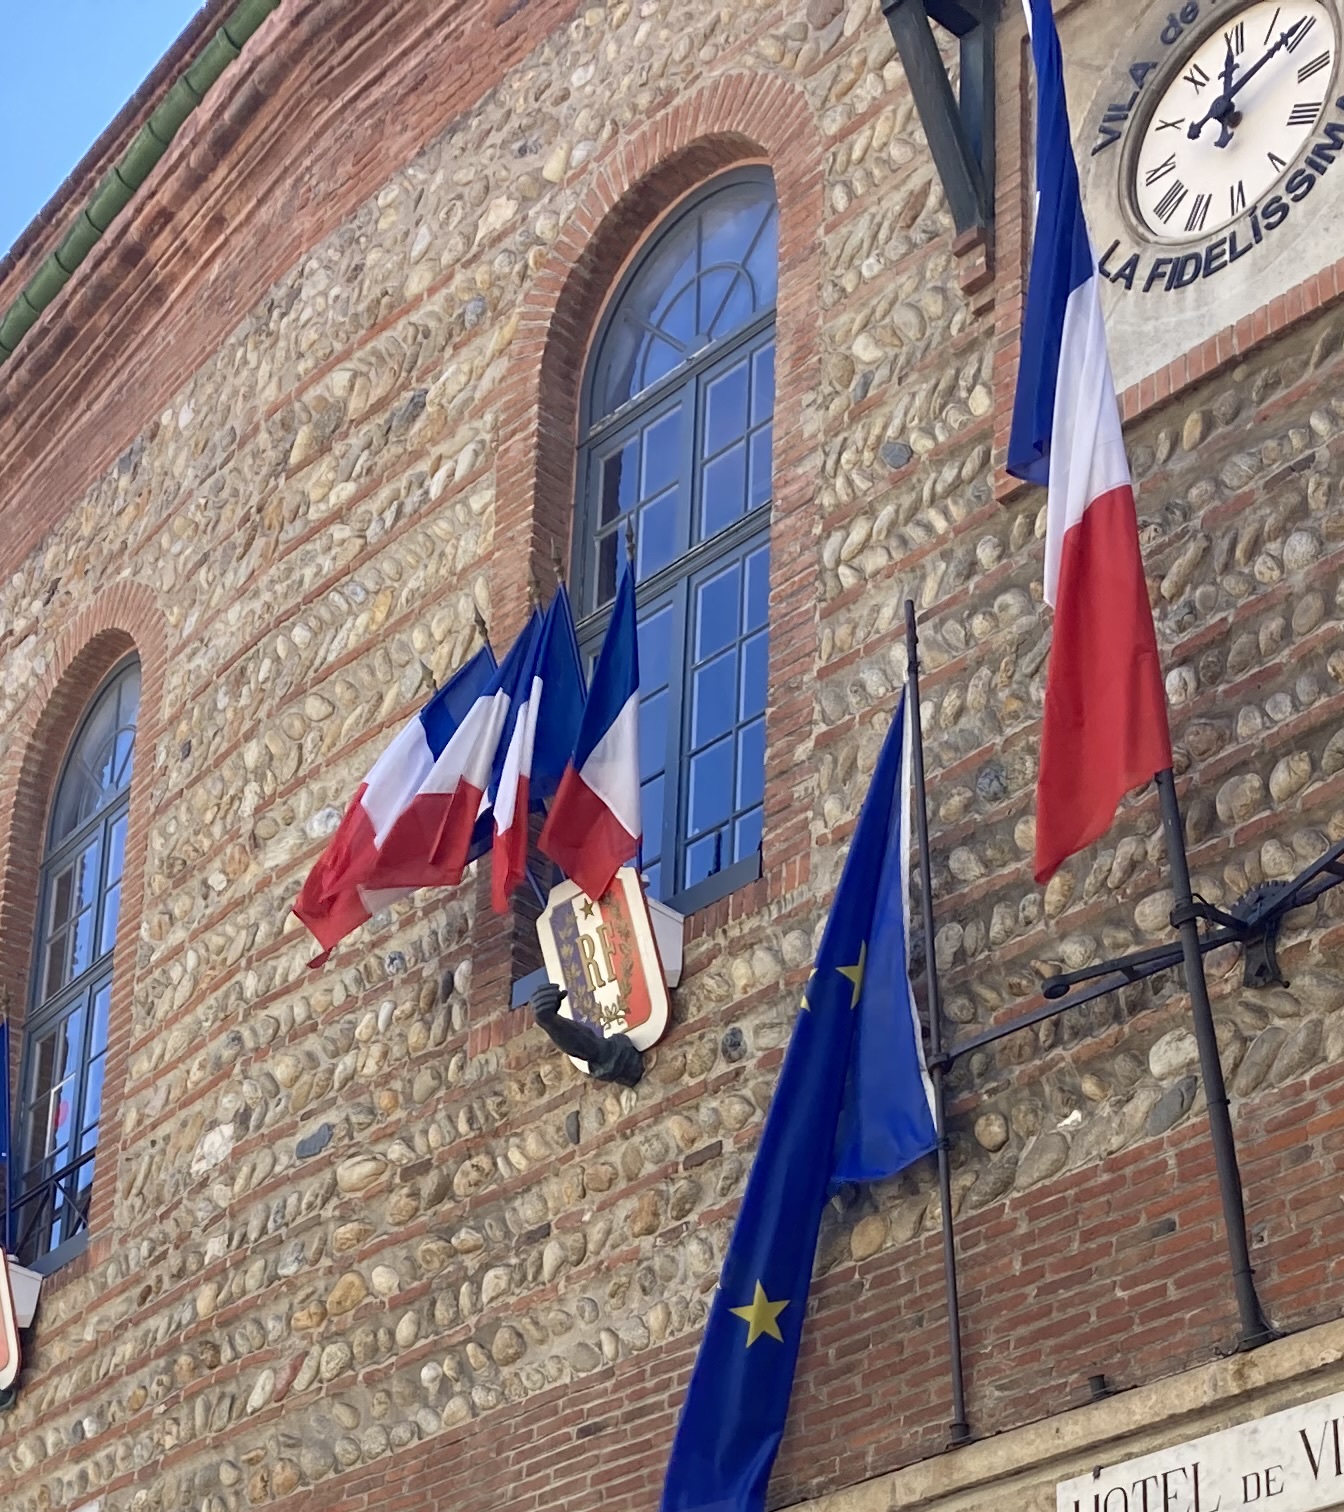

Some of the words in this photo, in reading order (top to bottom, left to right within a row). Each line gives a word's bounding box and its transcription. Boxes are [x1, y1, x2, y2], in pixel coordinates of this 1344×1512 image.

[1091, 61, 1158, 157] VILA
[1160, 0, 1199, 45] de
[1098, 239, 1139, 290] LA
[576, 920, 618, 993] RF
[1241, 1464, 1285, 1504] DE
